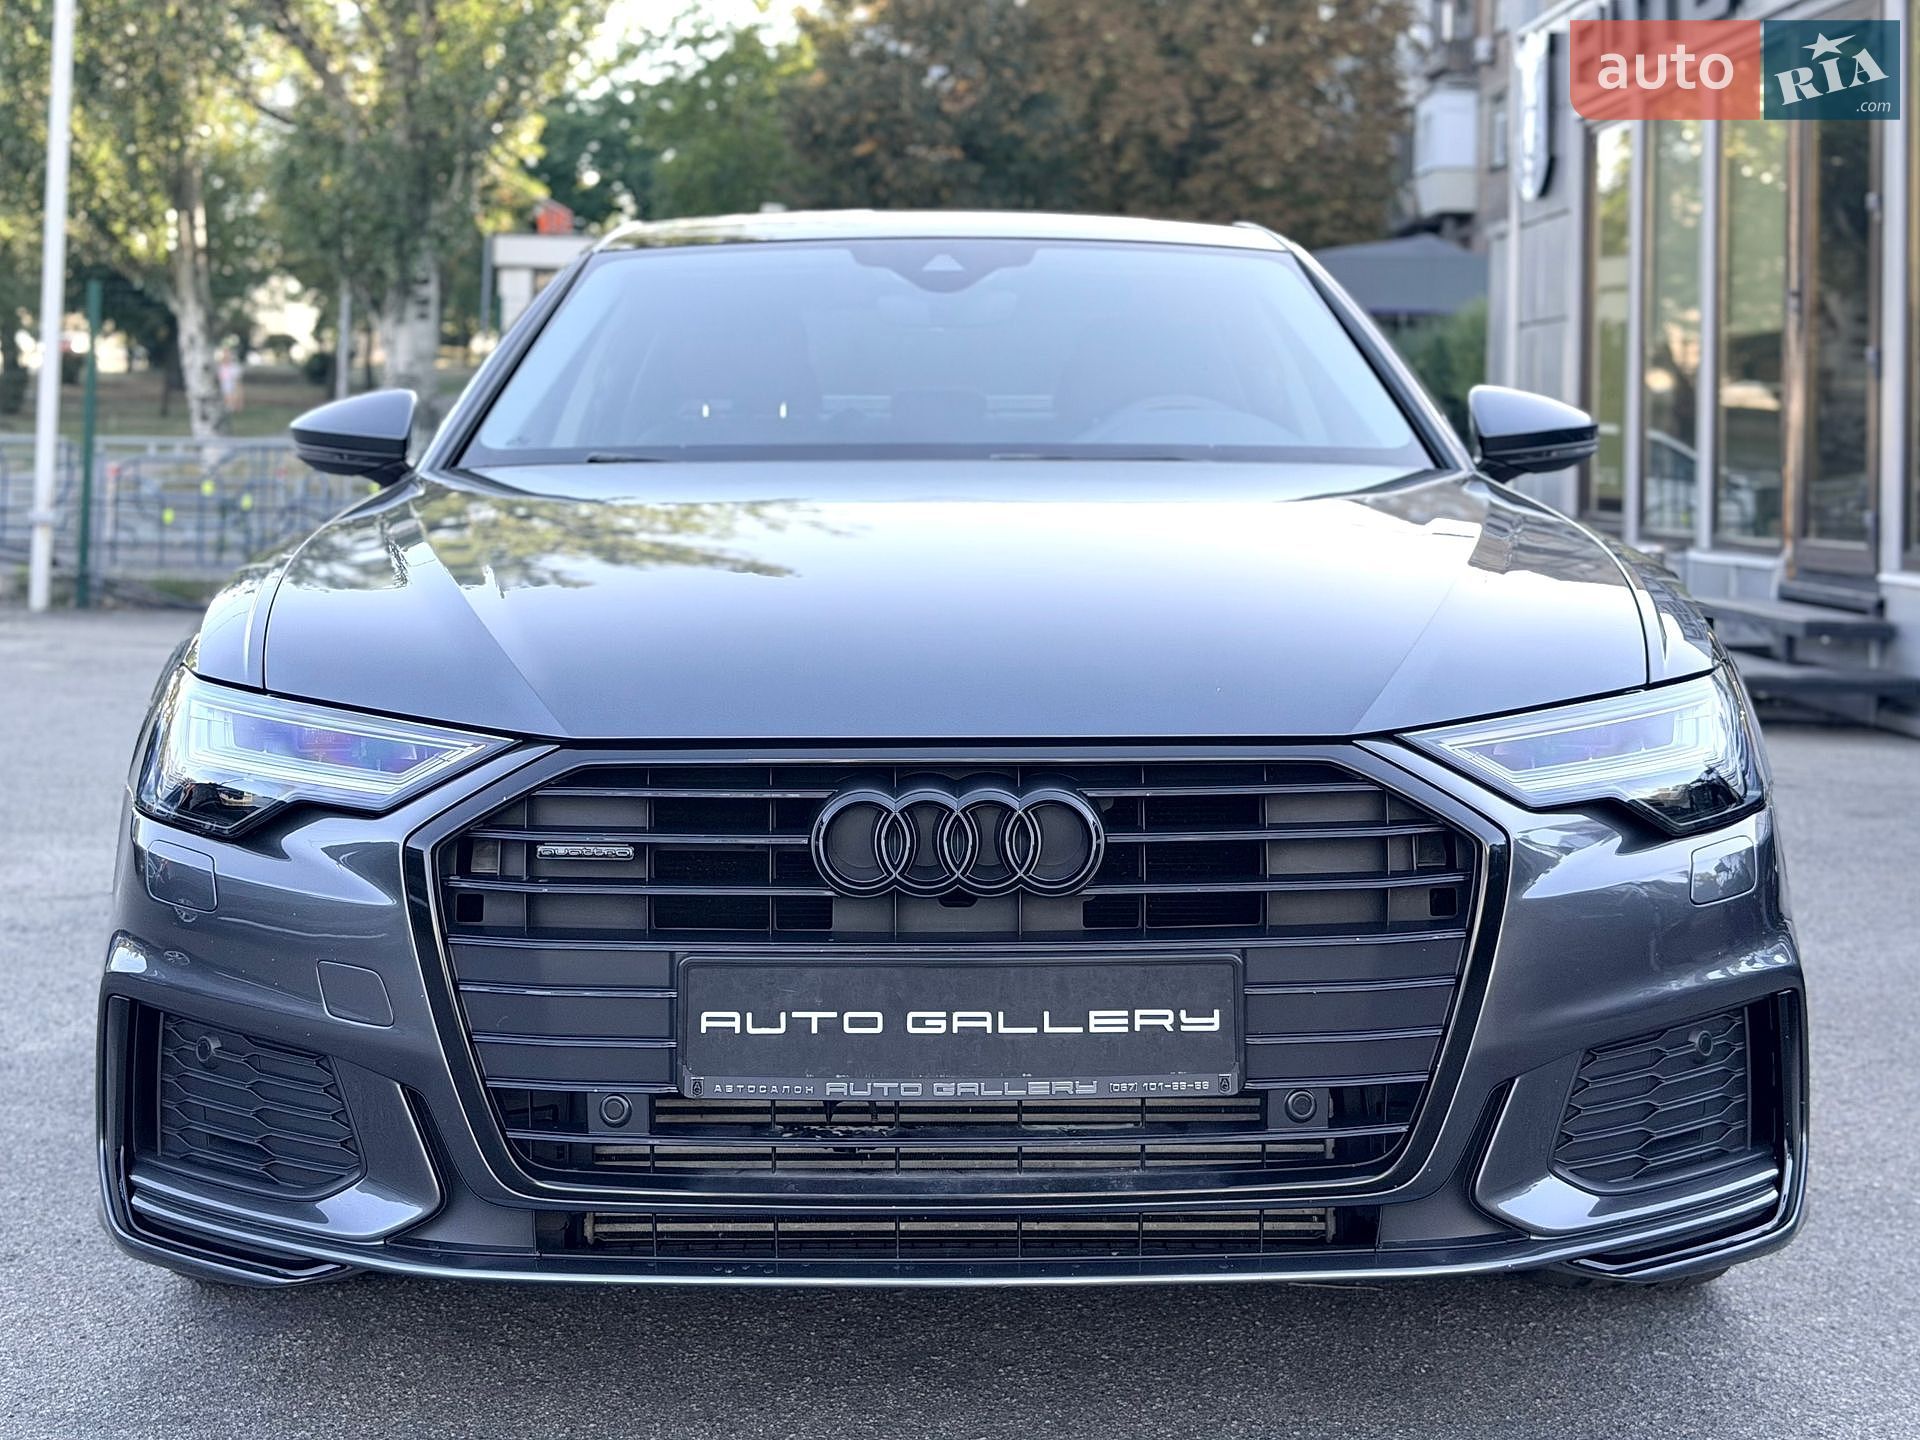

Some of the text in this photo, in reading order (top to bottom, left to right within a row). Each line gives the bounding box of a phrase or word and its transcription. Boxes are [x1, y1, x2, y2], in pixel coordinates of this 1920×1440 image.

[700, 1008, 1219, 1034] AUTO GALLERY
[713, 1084, 814, 1095] АВТОСАЛОН
[825, 1082, 923, 1097] AUTO
[933, 1080, 1097, 1096] GALLERY
